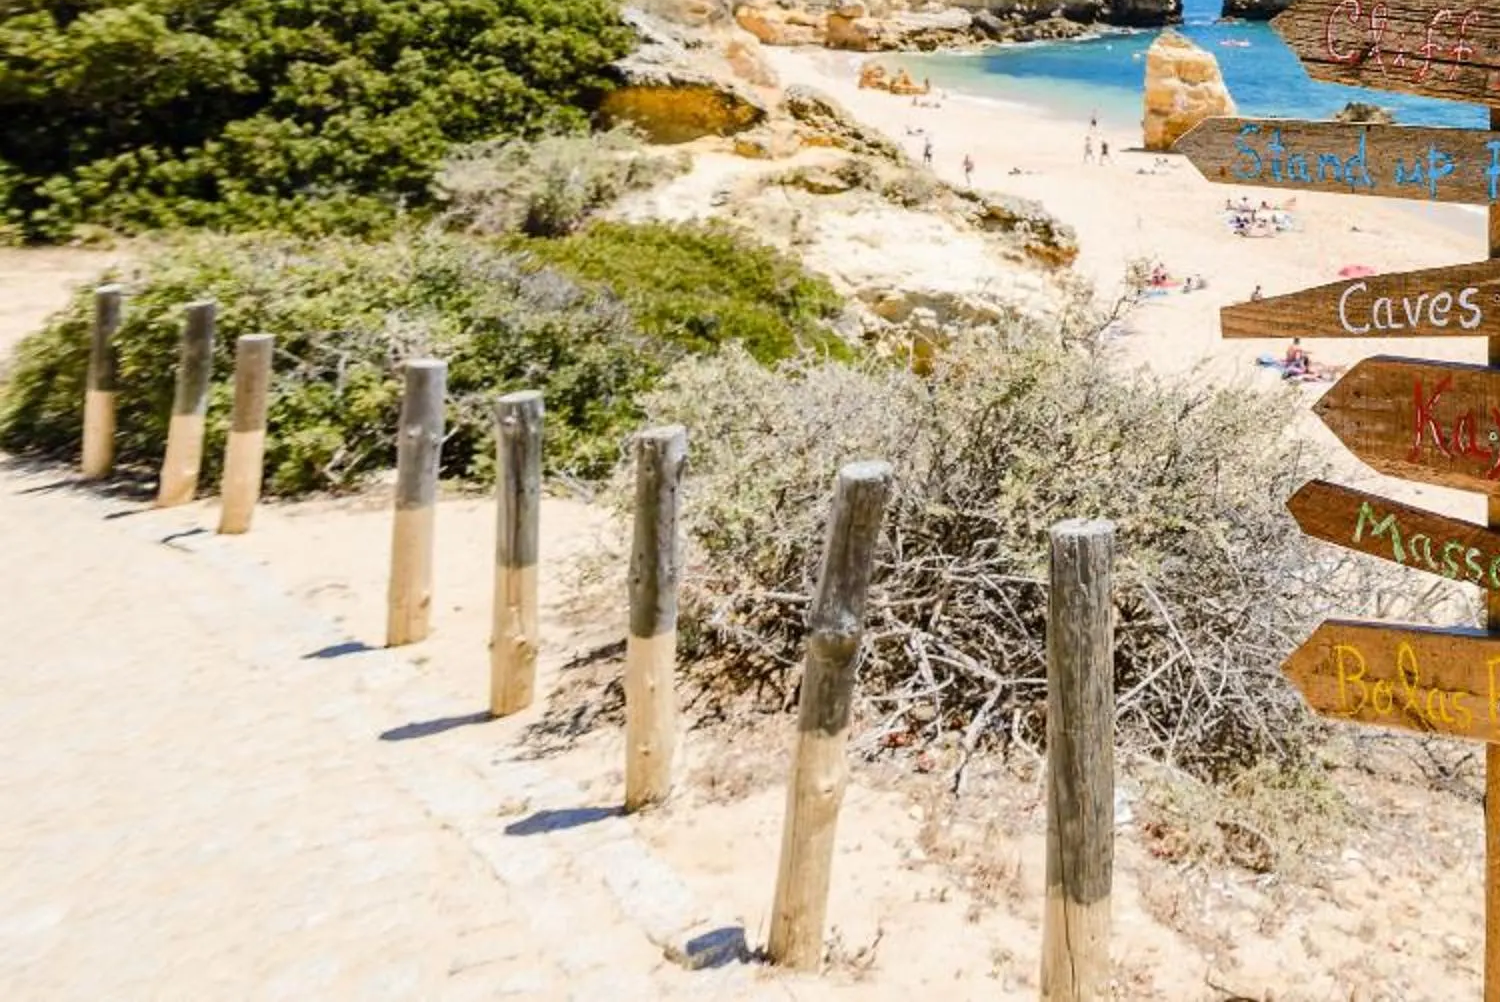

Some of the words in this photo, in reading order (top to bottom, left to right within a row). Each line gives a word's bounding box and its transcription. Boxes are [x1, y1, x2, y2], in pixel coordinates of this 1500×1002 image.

[1231, 122, 1377, 189] Stand
[1338, 281, 1484, 334] Caves
[1334, 641, 1475, 728] Bolas
